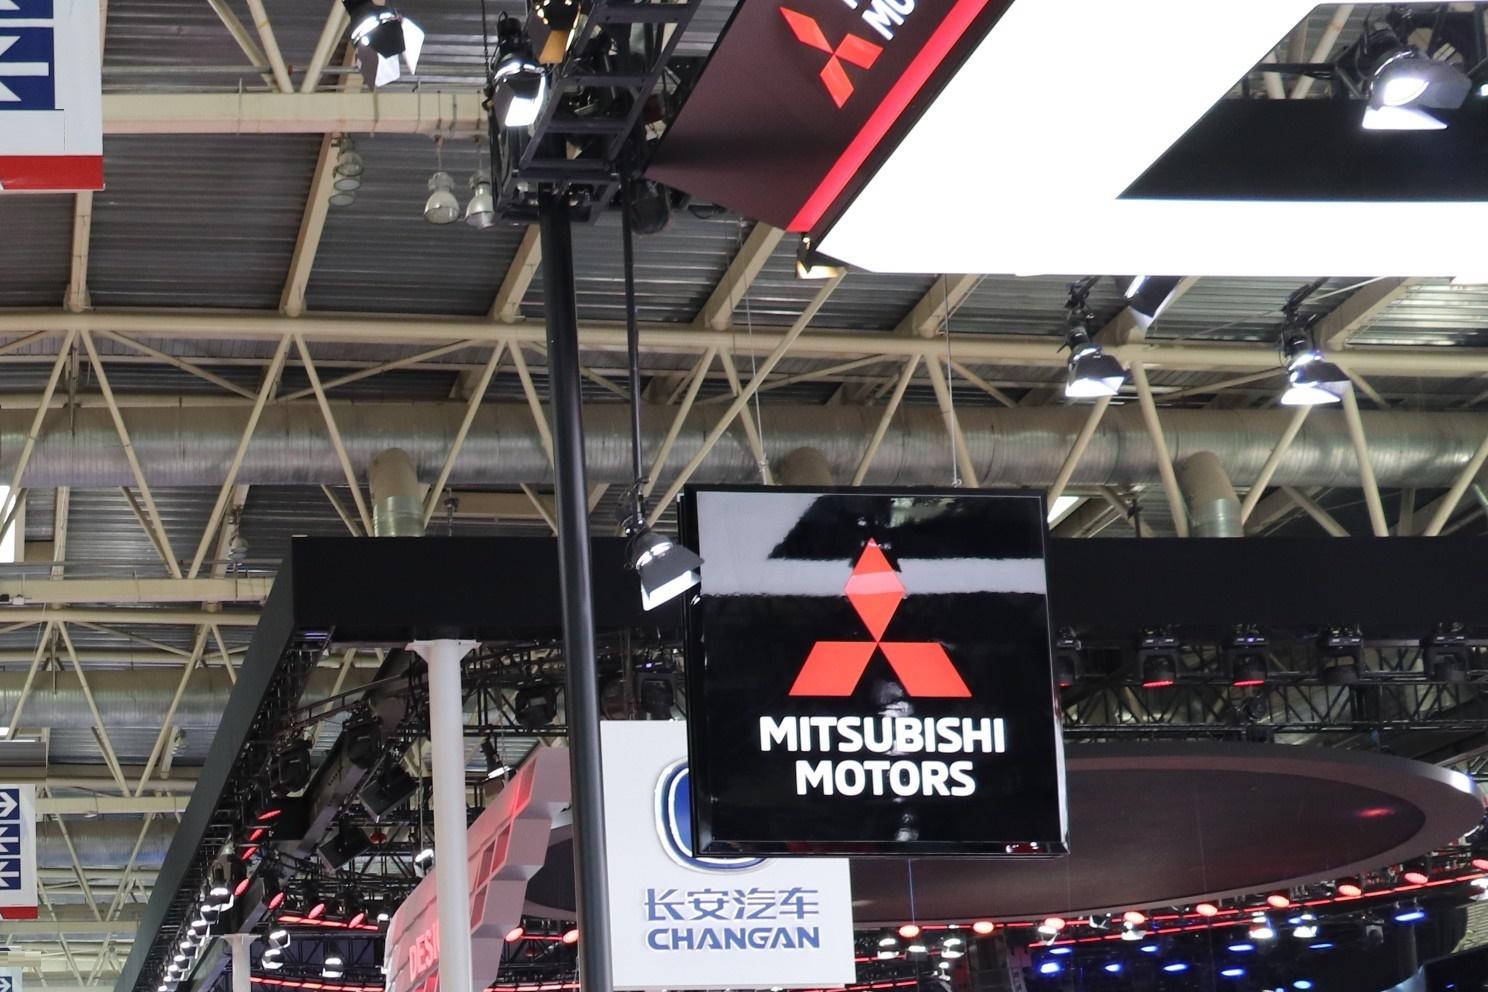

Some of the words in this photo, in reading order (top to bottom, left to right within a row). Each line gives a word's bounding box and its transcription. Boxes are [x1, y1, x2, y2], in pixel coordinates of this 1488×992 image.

[760, 716, 1005, 753] MITSUBISHI
[796, 760, 975, 796] MOTORS
[644, 888, 819, 920] 长安汽车
[409, 919, 440, 981] DESI
[648, 927, 820, 949] CHANGAN
